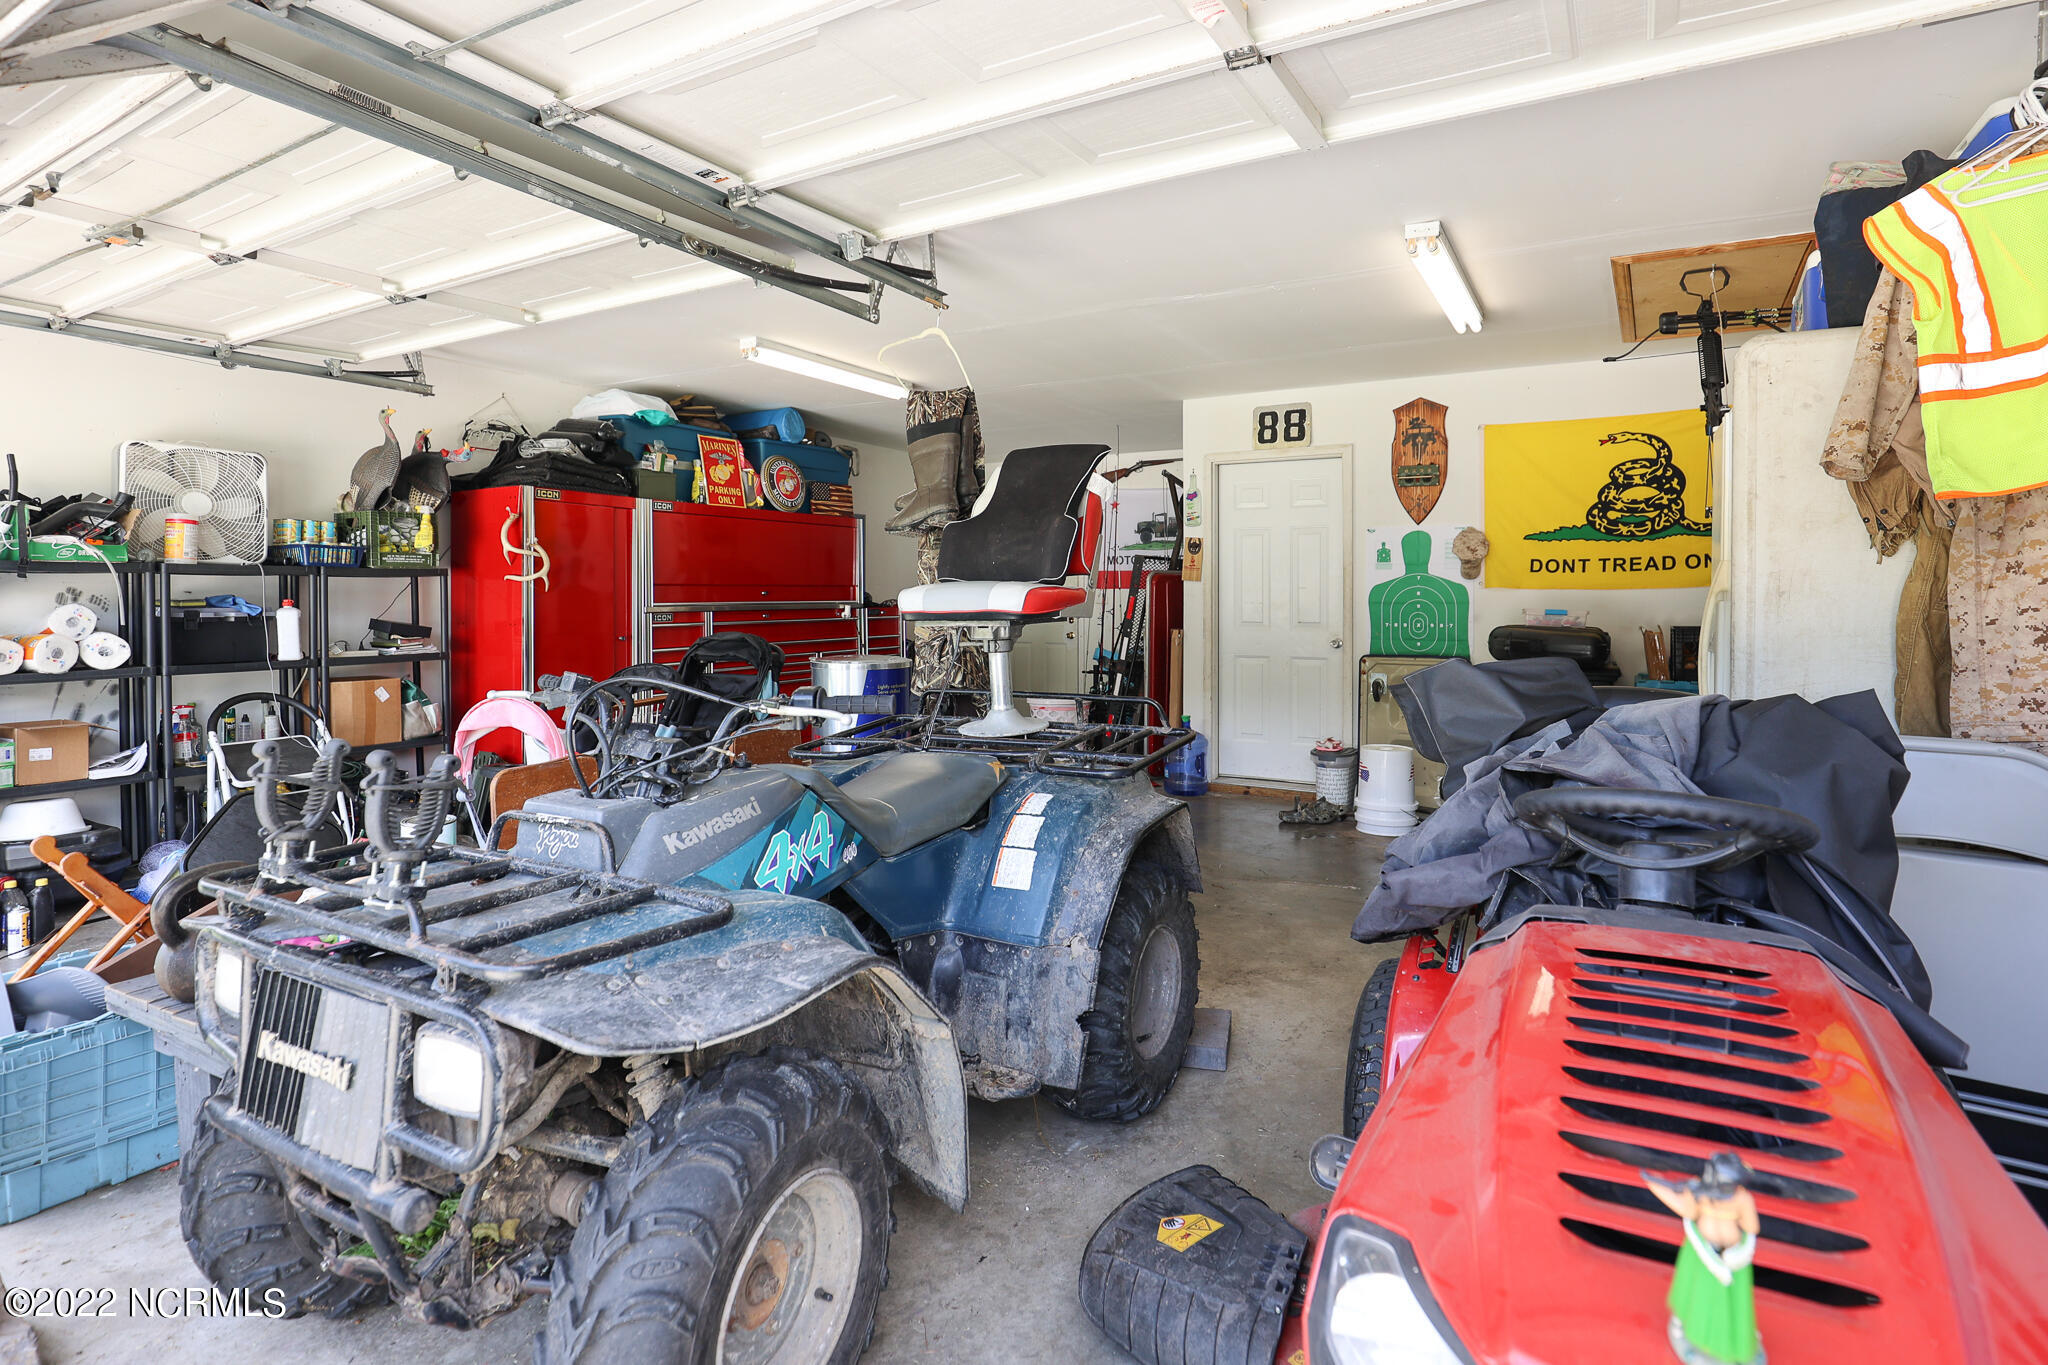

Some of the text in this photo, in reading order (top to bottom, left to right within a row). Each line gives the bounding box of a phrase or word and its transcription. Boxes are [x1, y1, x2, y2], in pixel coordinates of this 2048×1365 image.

[1257, 408, 1307, 444] 88
[702, 439, 737, 457] MARINES
[537, 489, 559, 499] ICON
[708, 485, 741, 496] PARKING
[654, 501, 672, 510] ICON
[718, 495, 736, 505] ONLY
[1529, 558, 1591, 573] DONT
[1598, 555, 1677, 572] TREAD
[654, 613, 672, 621] ICON
[662, 795, 762, 856] Kawasaki
[842, 841, 858, 863] 400
[257, 1029, 353, 1092] Kawasaki
